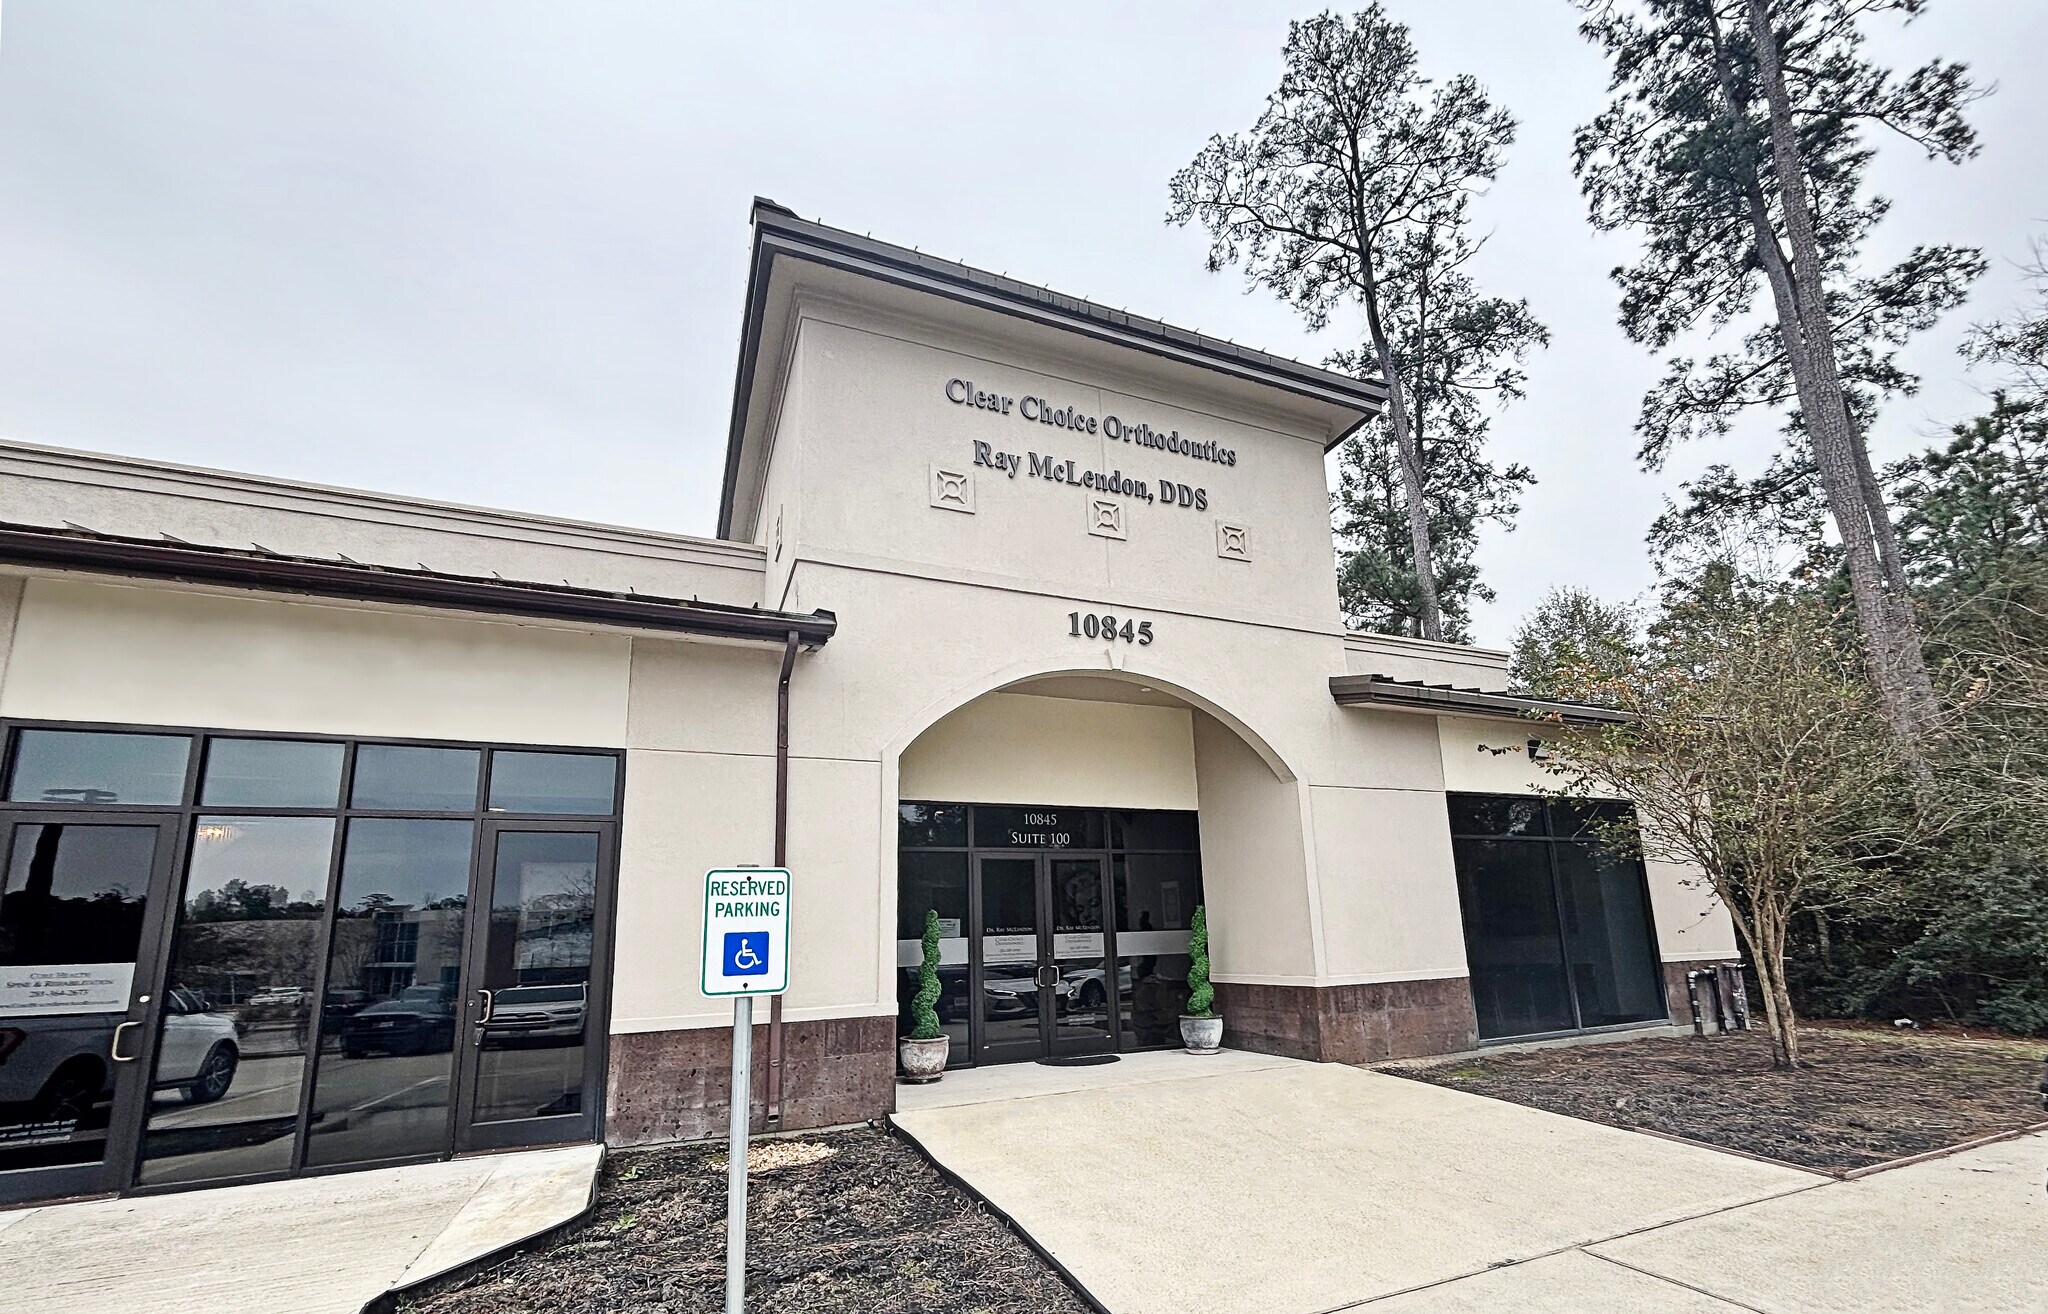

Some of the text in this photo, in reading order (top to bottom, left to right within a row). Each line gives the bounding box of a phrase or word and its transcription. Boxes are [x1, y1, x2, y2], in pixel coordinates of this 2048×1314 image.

[945, 377, 1237, 467] Clear Choice Orthodontics
[973, 439, 1209, 512] Ray McLendon, DDS
[1068, 611, 1154, 645] 10845
[1024, 813, 1057, 825] 10845
[1011, 831, 1070, 845] SUITE 100
[710, 880, 786, 896] RESERVED
[715, 901, 780, 918] PARKING
